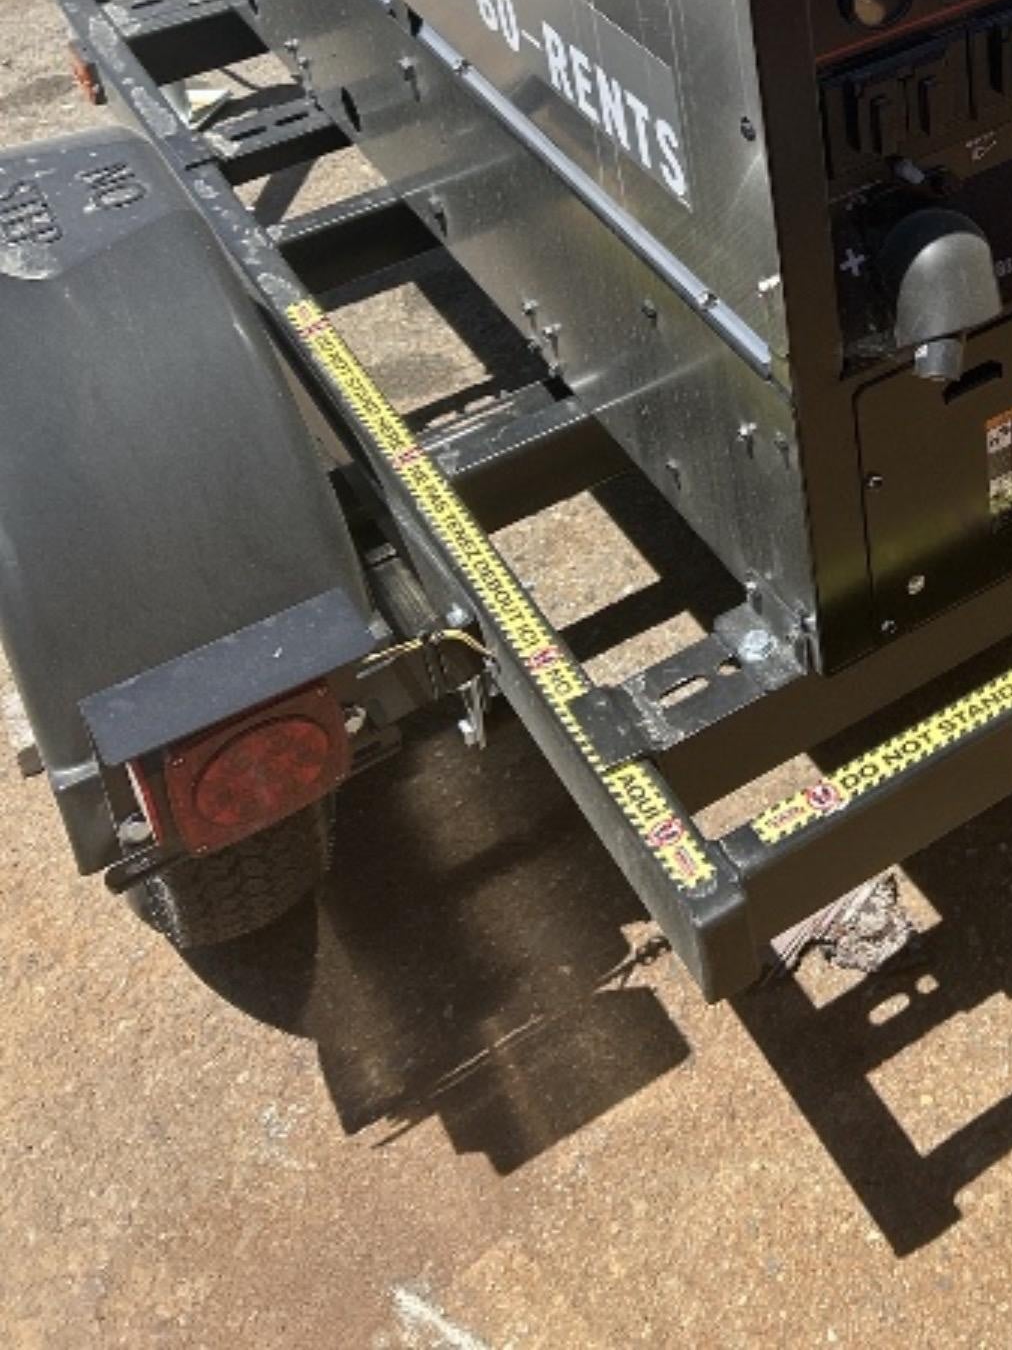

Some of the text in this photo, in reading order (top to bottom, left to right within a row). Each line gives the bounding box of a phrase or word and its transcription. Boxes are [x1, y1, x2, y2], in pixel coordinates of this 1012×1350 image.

[839, 760, 880, 791] DO
[881, 729, 934, 768] NOT
[617, 771, 662, 822] AQUI
